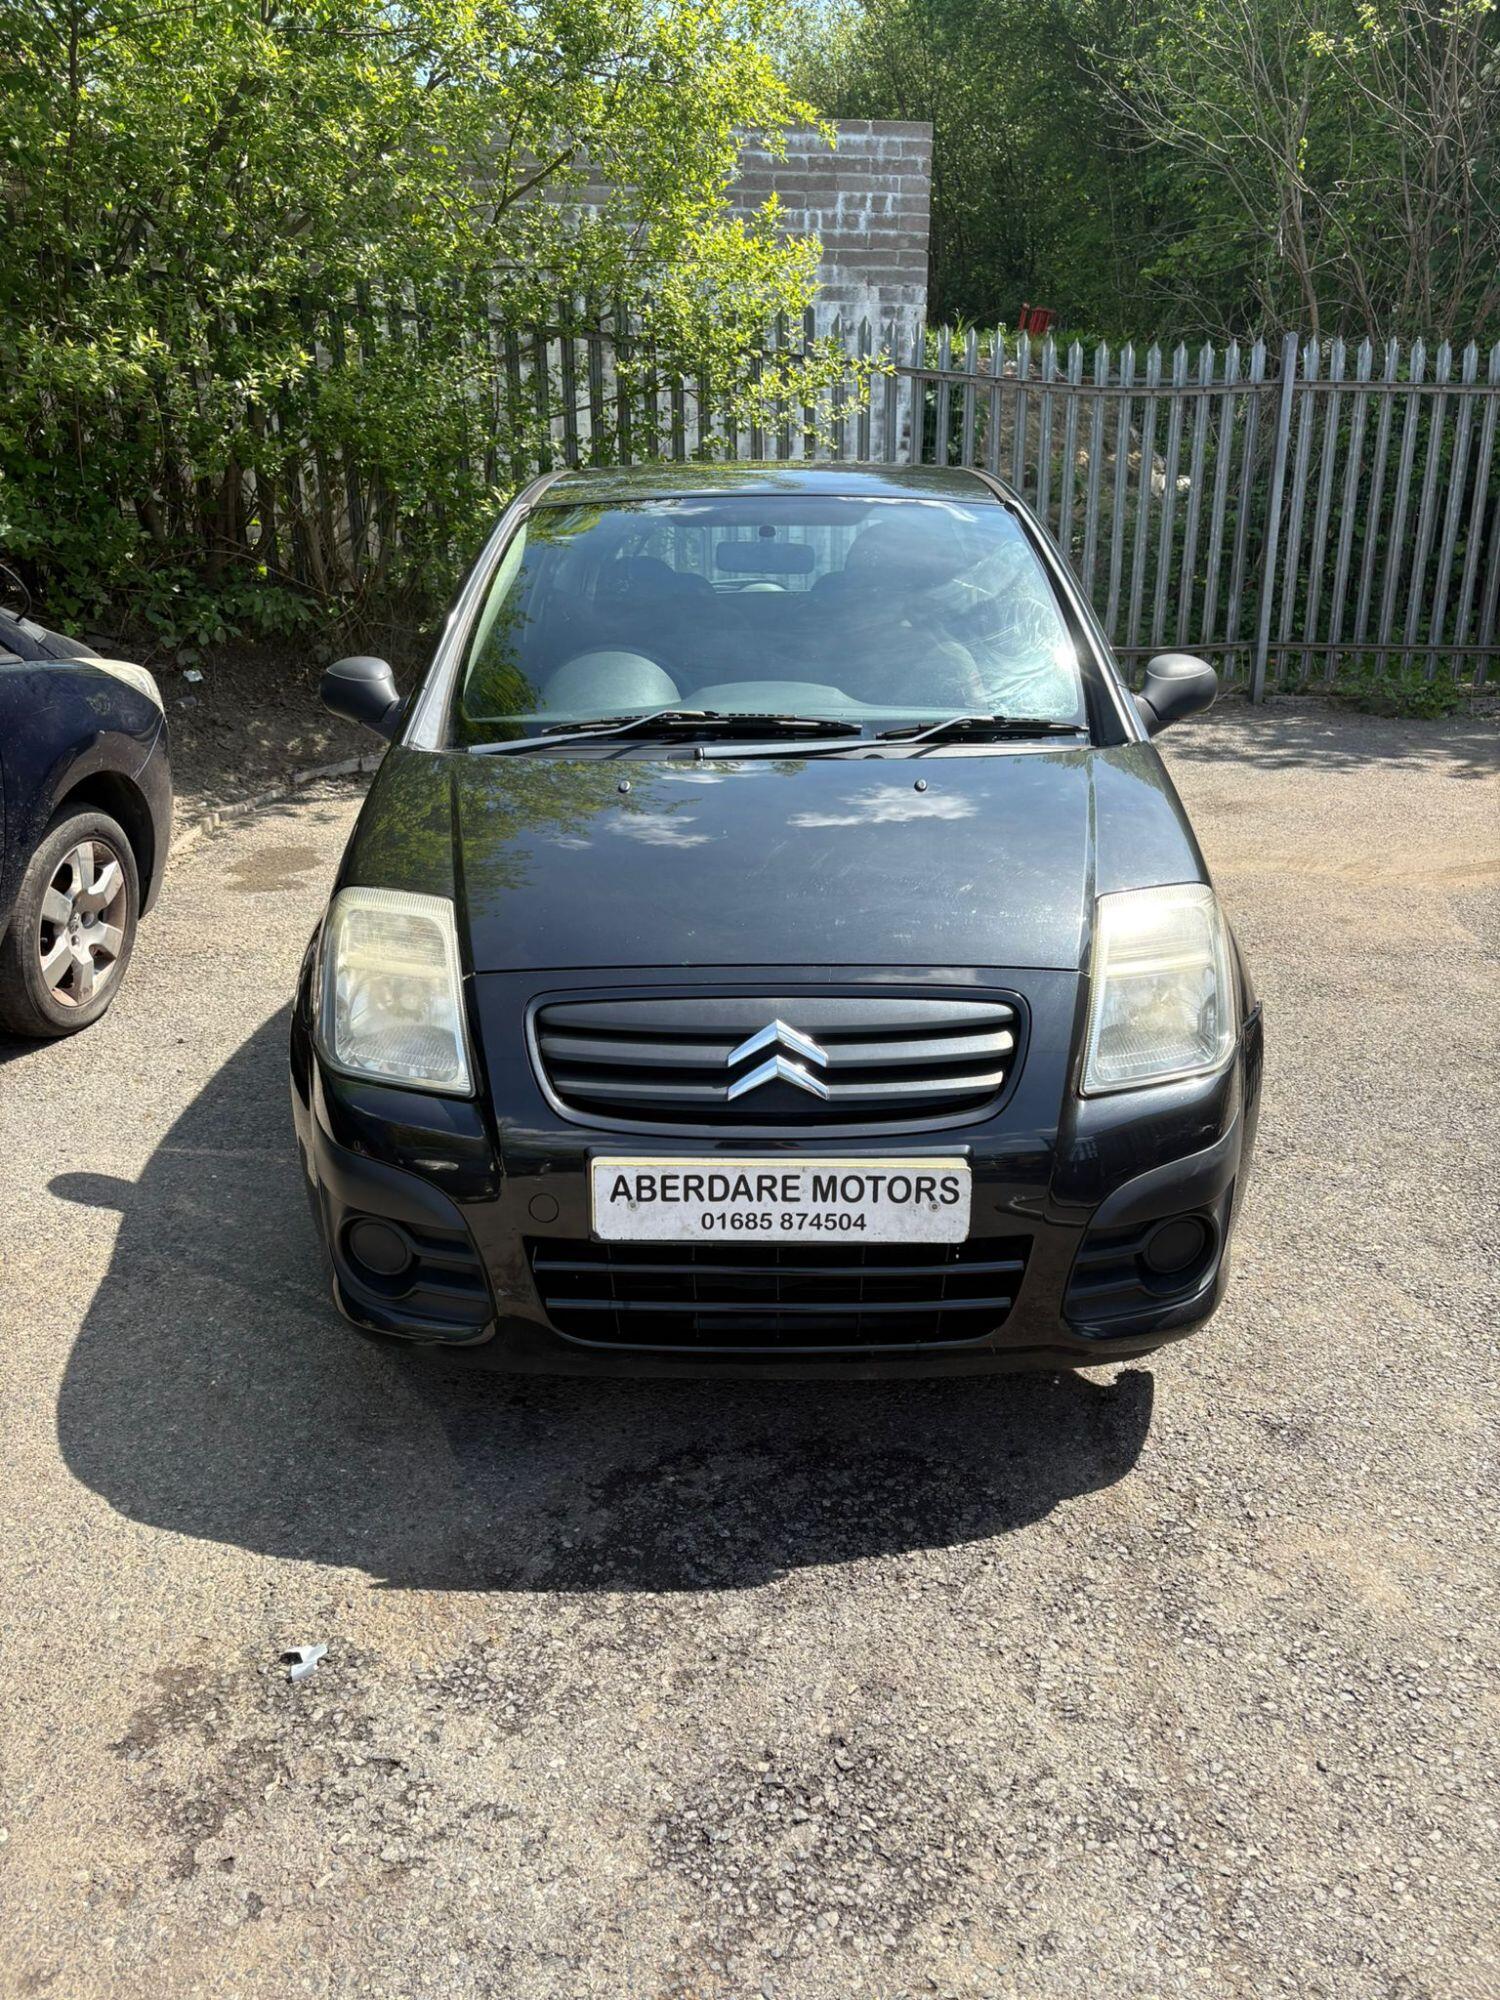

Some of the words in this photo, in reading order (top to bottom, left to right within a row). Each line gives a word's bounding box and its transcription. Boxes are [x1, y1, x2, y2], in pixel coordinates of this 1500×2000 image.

[609, 1174, 801, 1203] ABERDARE
[812, 1174, 960, 1205] MOTORS
[701, 1212, 773, 1230] 01685
[780, 1212, 867, 1231] 874504
